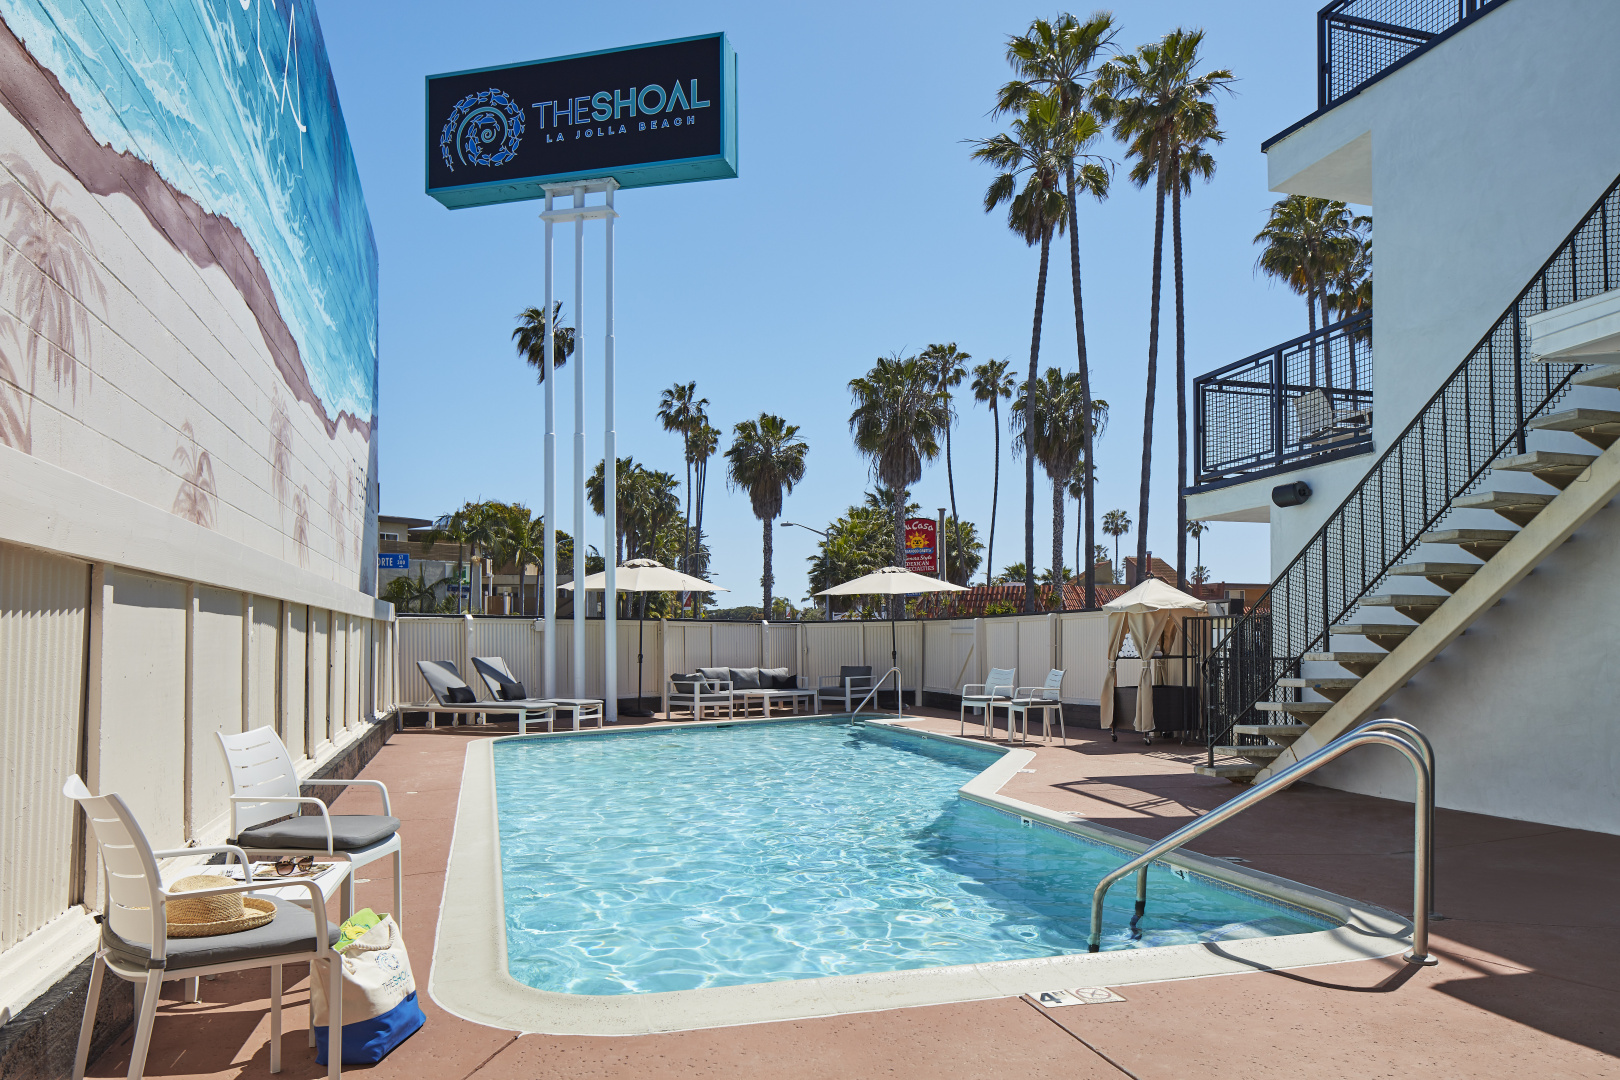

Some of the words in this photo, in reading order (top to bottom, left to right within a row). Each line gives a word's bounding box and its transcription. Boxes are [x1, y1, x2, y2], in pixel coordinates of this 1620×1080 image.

[546, 132, 564, 144] LA
[575, 124, 627, 140] JOLLA
[638, 115, 696, 132] BEACH
[912, 521, 933, 531] Casa
[378, 557, 394, 567] ORTE
[1174, 869, 1185, 880] 4
[1040, 992, 1062, 1003] 4
